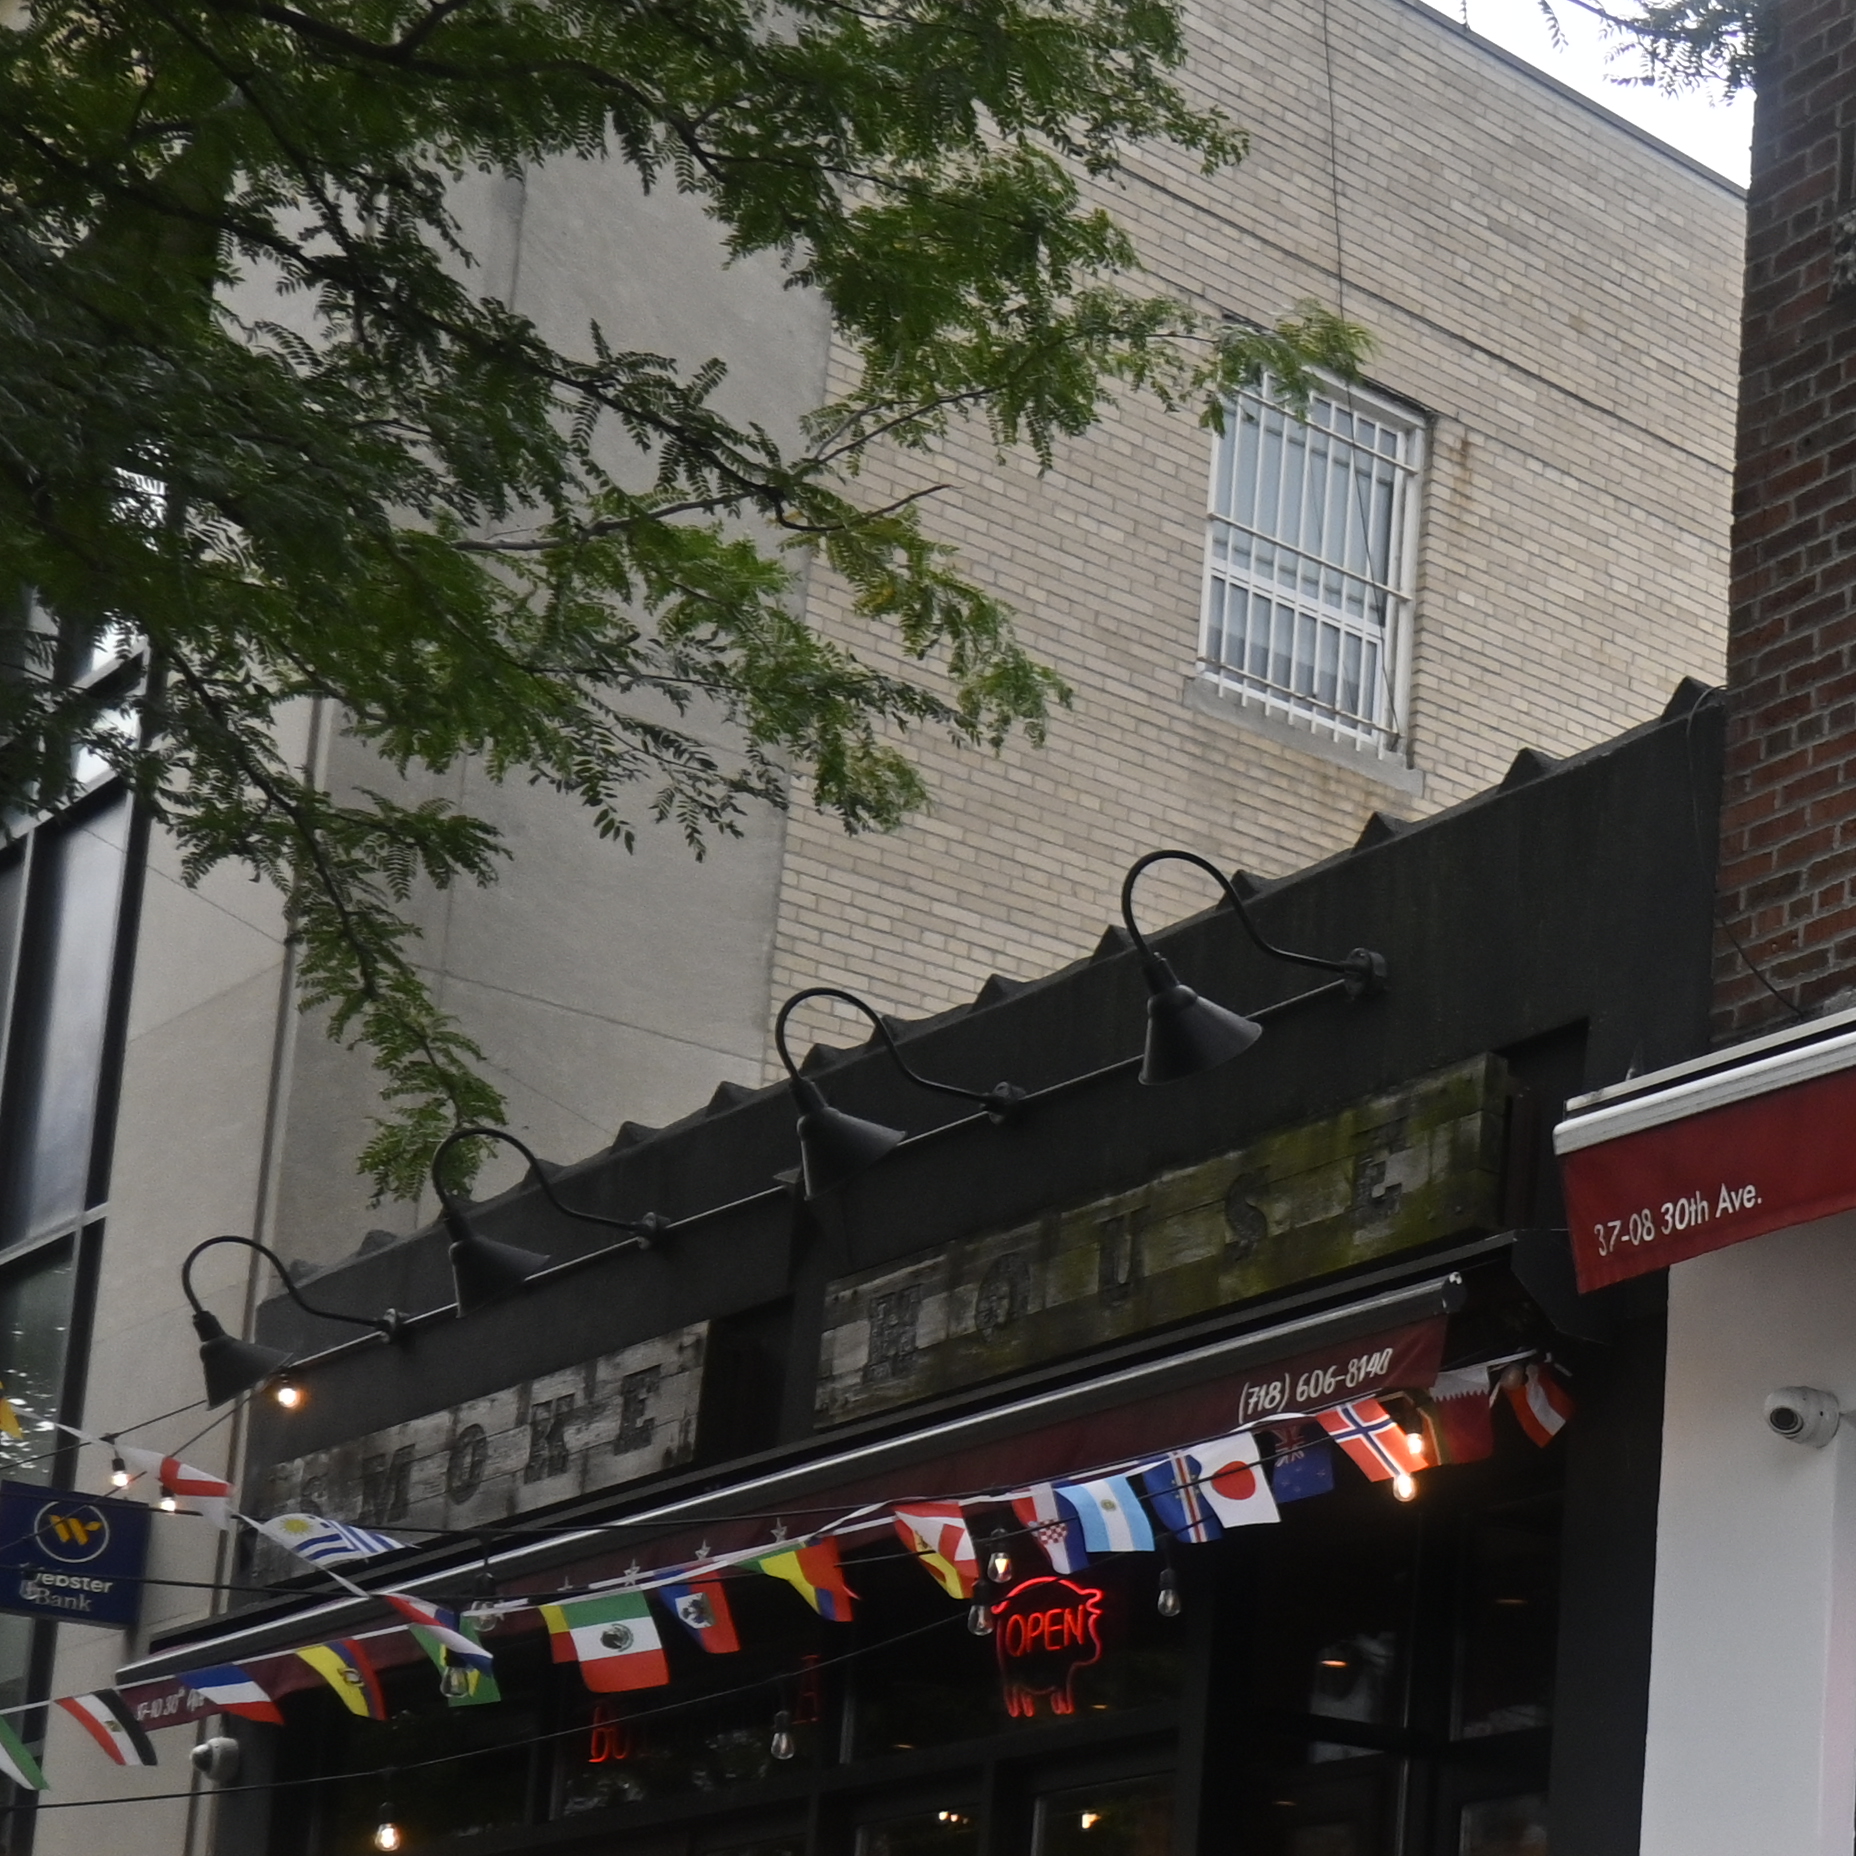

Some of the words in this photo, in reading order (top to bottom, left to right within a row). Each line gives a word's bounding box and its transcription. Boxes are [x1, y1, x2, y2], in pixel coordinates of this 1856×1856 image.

[863, 1118, 1412, 1383] HOUSE
[1594, 1208, 1655, 1256] 37-08
[1660, 1190, 1709, 1235] 30th
[1715, 1183, 1762, 1218] Ave.
[1239, 1373, 1290, 1425] (718)
[1296, 1348, 1393, 1401] 606-8140
[34, 1586, 92, 1611] Bank
[1005, 1604, 1084, 1657] OPEN
